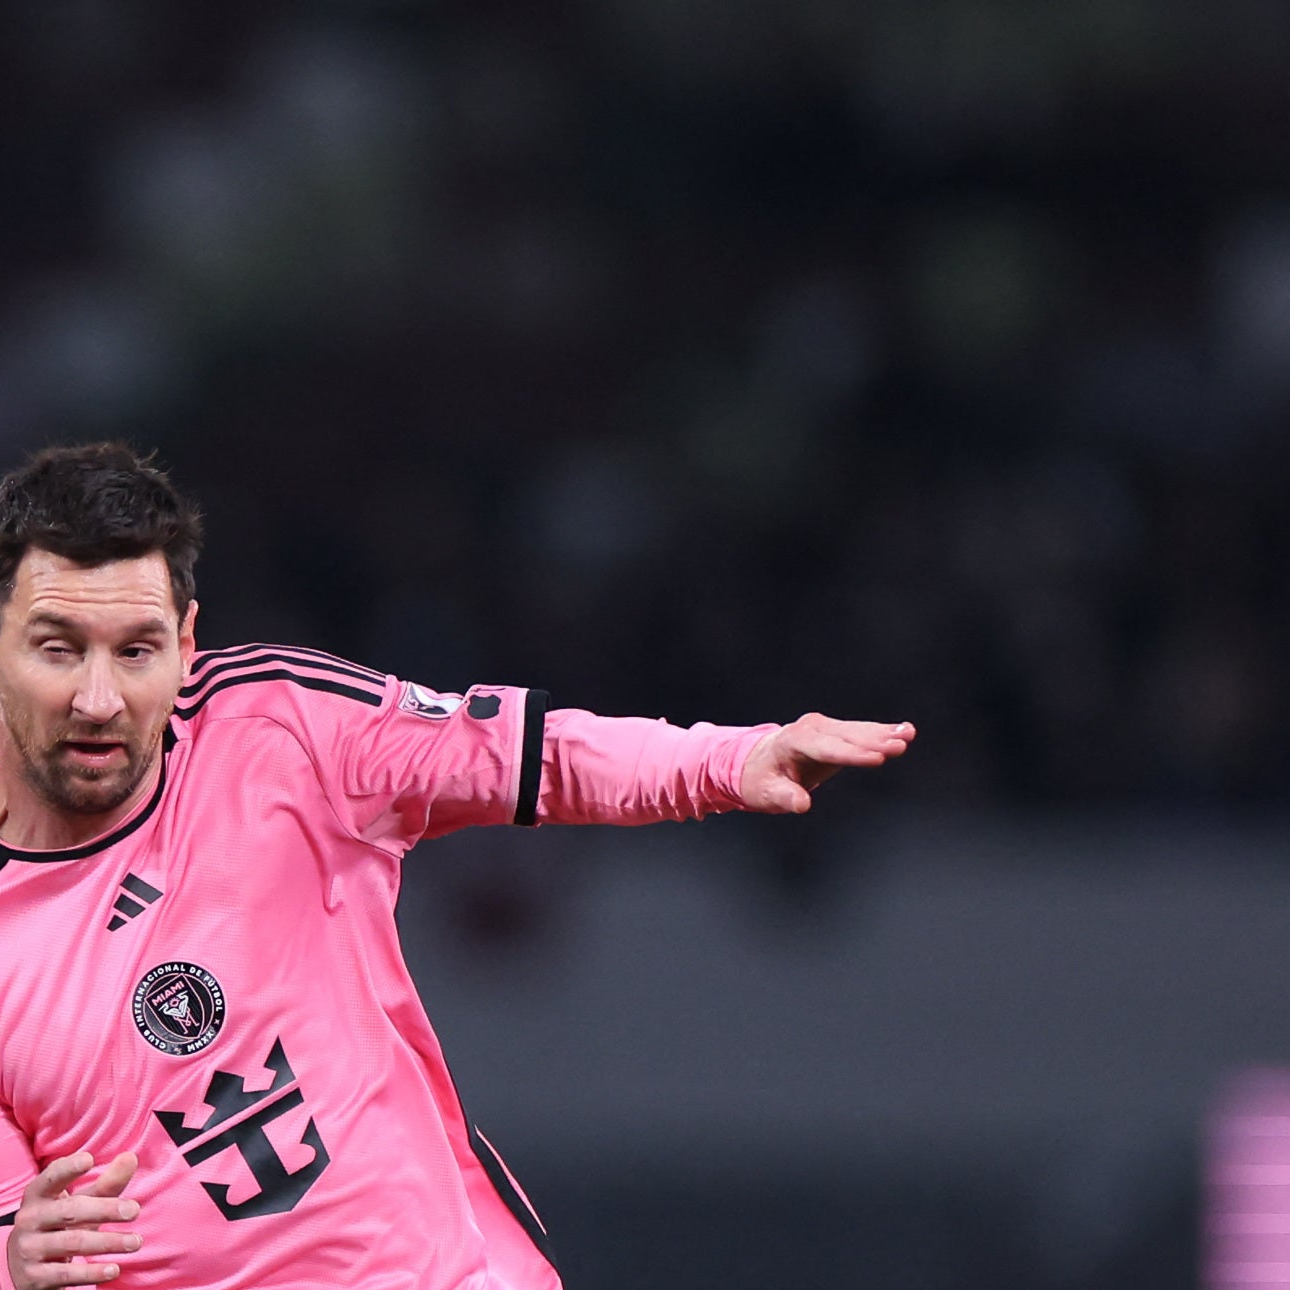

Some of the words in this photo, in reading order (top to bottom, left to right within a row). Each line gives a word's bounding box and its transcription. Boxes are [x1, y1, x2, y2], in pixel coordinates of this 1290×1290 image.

[189, 966, 203, 977] DE
[134, 964, 186, 1027] INTERNACIONAL
[152, 980, 186, 1006] MIAMI
[203, 974, 223, 1012] FÚTBOL
[143, 1029, 167, 1050] CLUB
[187, 1031, 215, 1053] MMXX
